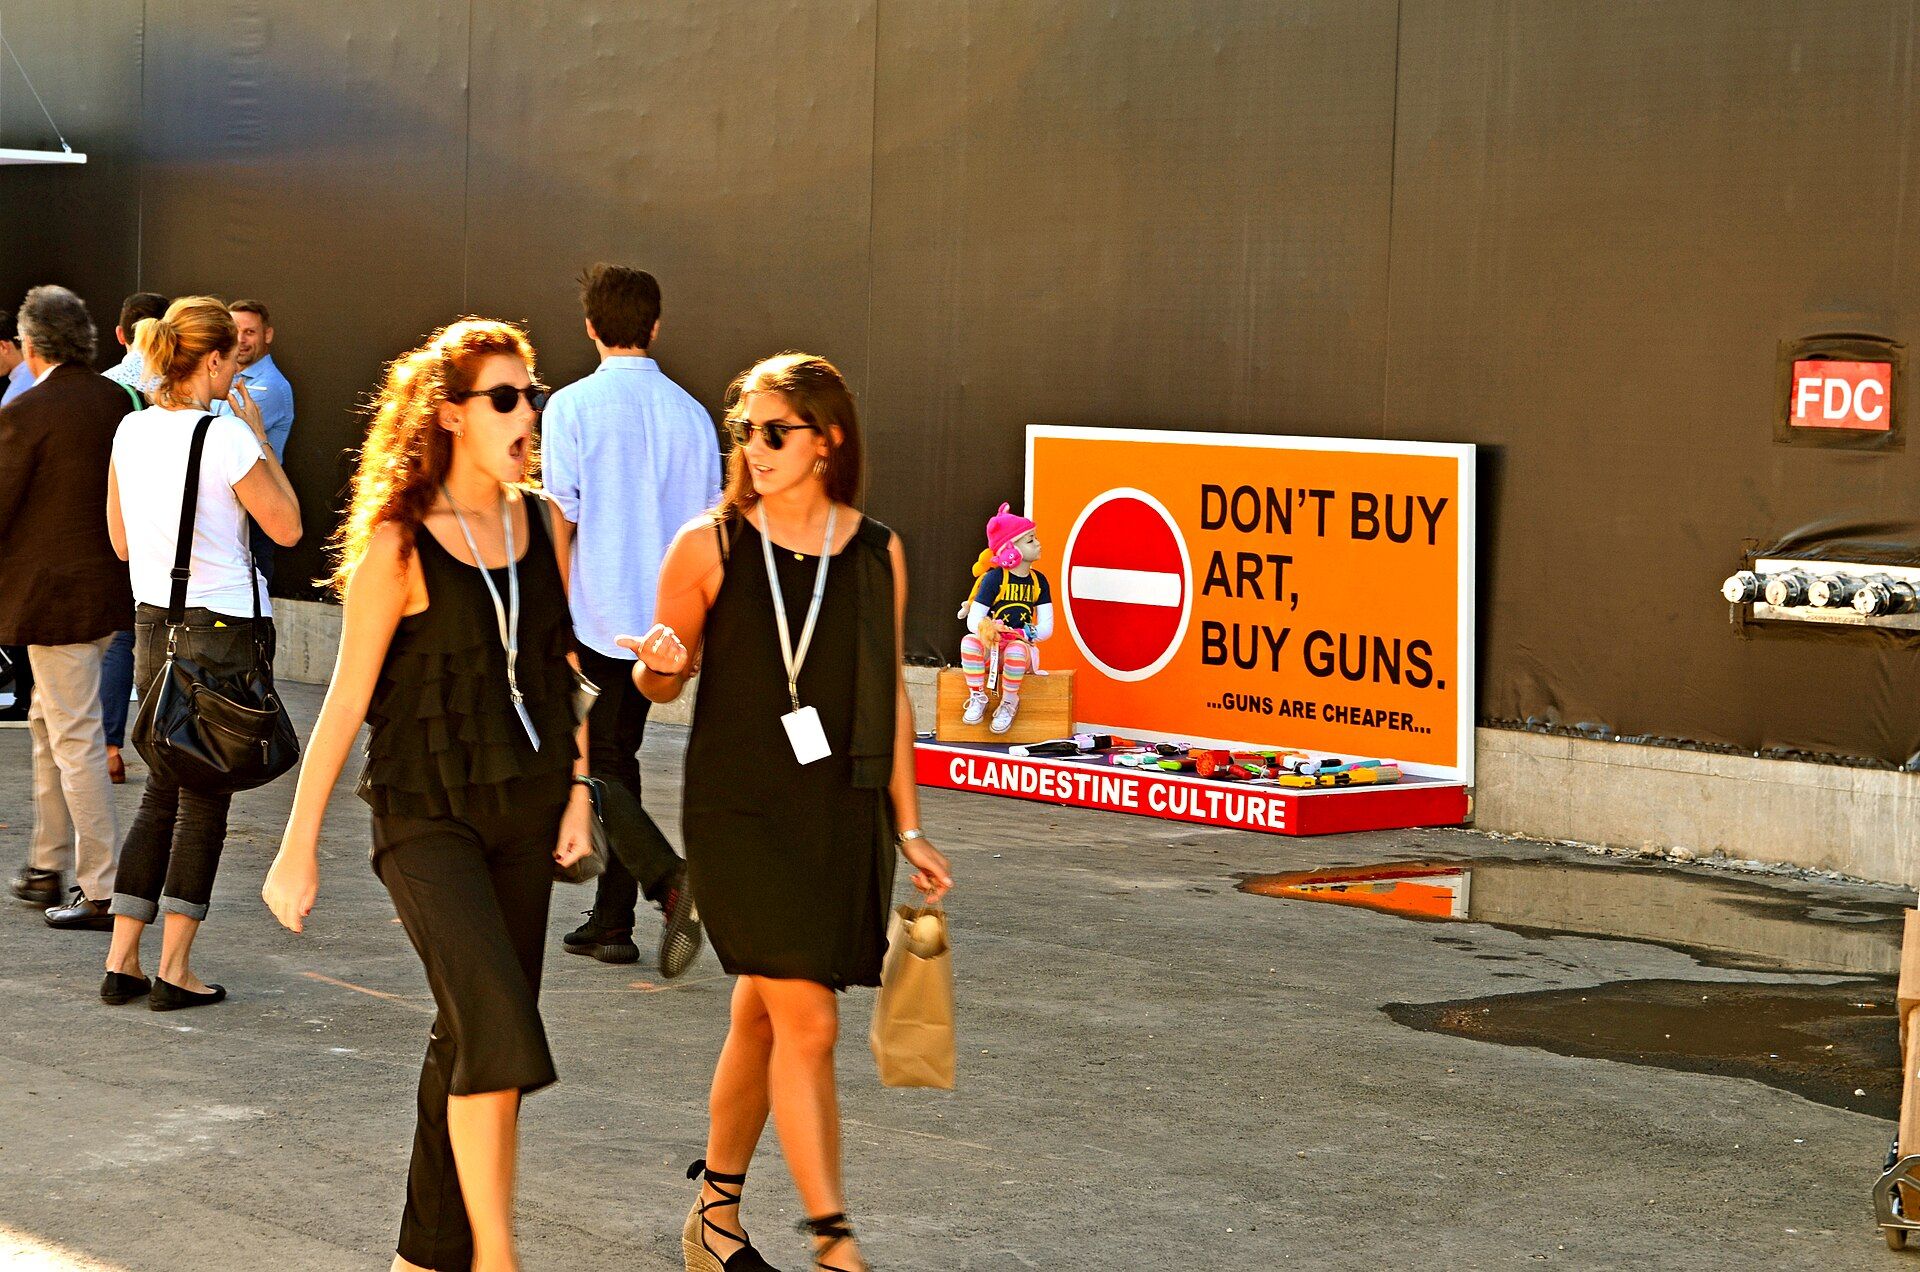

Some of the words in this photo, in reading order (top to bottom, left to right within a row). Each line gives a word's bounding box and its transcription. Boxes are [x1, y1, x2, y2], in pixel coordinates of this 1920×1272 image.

[1797, 377, 1883, 422] FDC
[1201, 484, 1335, 537] DON'T
[1351, 492, 1449, 546] BUY
[1201, 551, 1299, 612] ART,
[1201, 621, 1291, 673] BUY
[1303, 630, 1446, 690] GUNS.
[1206, 693, 1274, 716] ...GUNS
[1278, 700, 1317, 720] ARE
[1322, 704, 1431, 734] CHEAPER...
[949, 757, 1139, 808] CLANDESTINE
[1148, 783, 1286, 829] CULTURE
